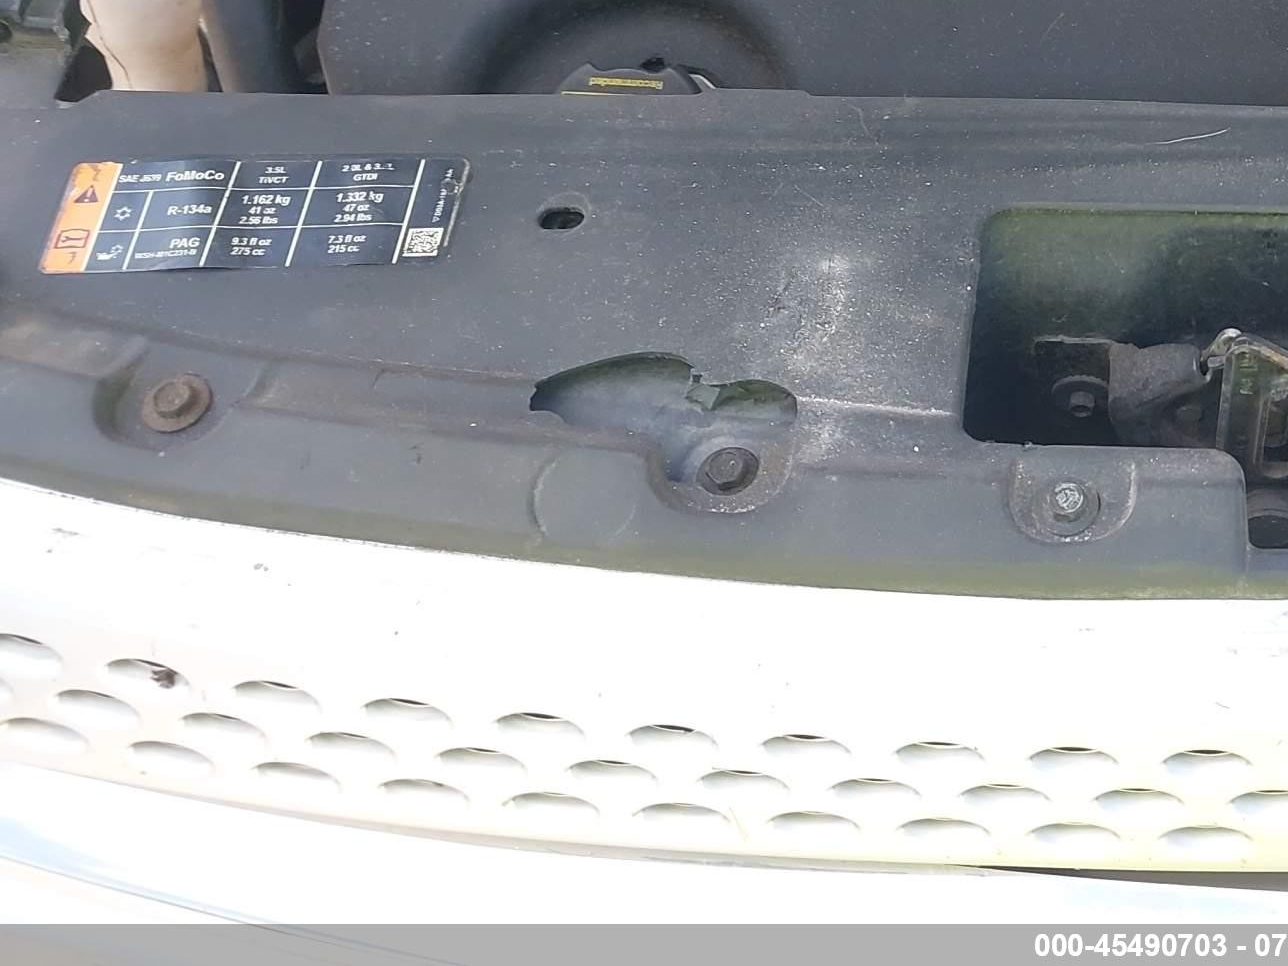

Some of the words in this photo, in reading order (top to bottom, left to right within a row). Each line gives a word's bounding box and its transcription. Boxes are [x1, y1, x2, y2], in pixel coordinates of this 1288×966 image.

[364, 163, 372, 171] &
[119, 175, 138, 183] SAE
[165, 170, 225, 182] FoMoCo
[242, 195, 273, 205] 1.162
[275, 195, 291, 206] kg
[336, 192, 367, 202] 1.332
[368, 191, 384, 203] kg
[167, 204, 212, 215] R-134a
[248, 207, 261, 215] 41
[343, 204, 356, 212] 47
[262, 216, 279, 224] lbs
[357, 214, 372, 222] lbs
[231, 237, 248, 245] 9.3
[249, 237, 258, 245] fl
[328, 235, 343, 243] 7.3
[344, 234, 353, 242] fl
[169, 237, 201, 249] PAG
[230, 247, 251, 255] 275
[328, 245, 346, 253] 215
